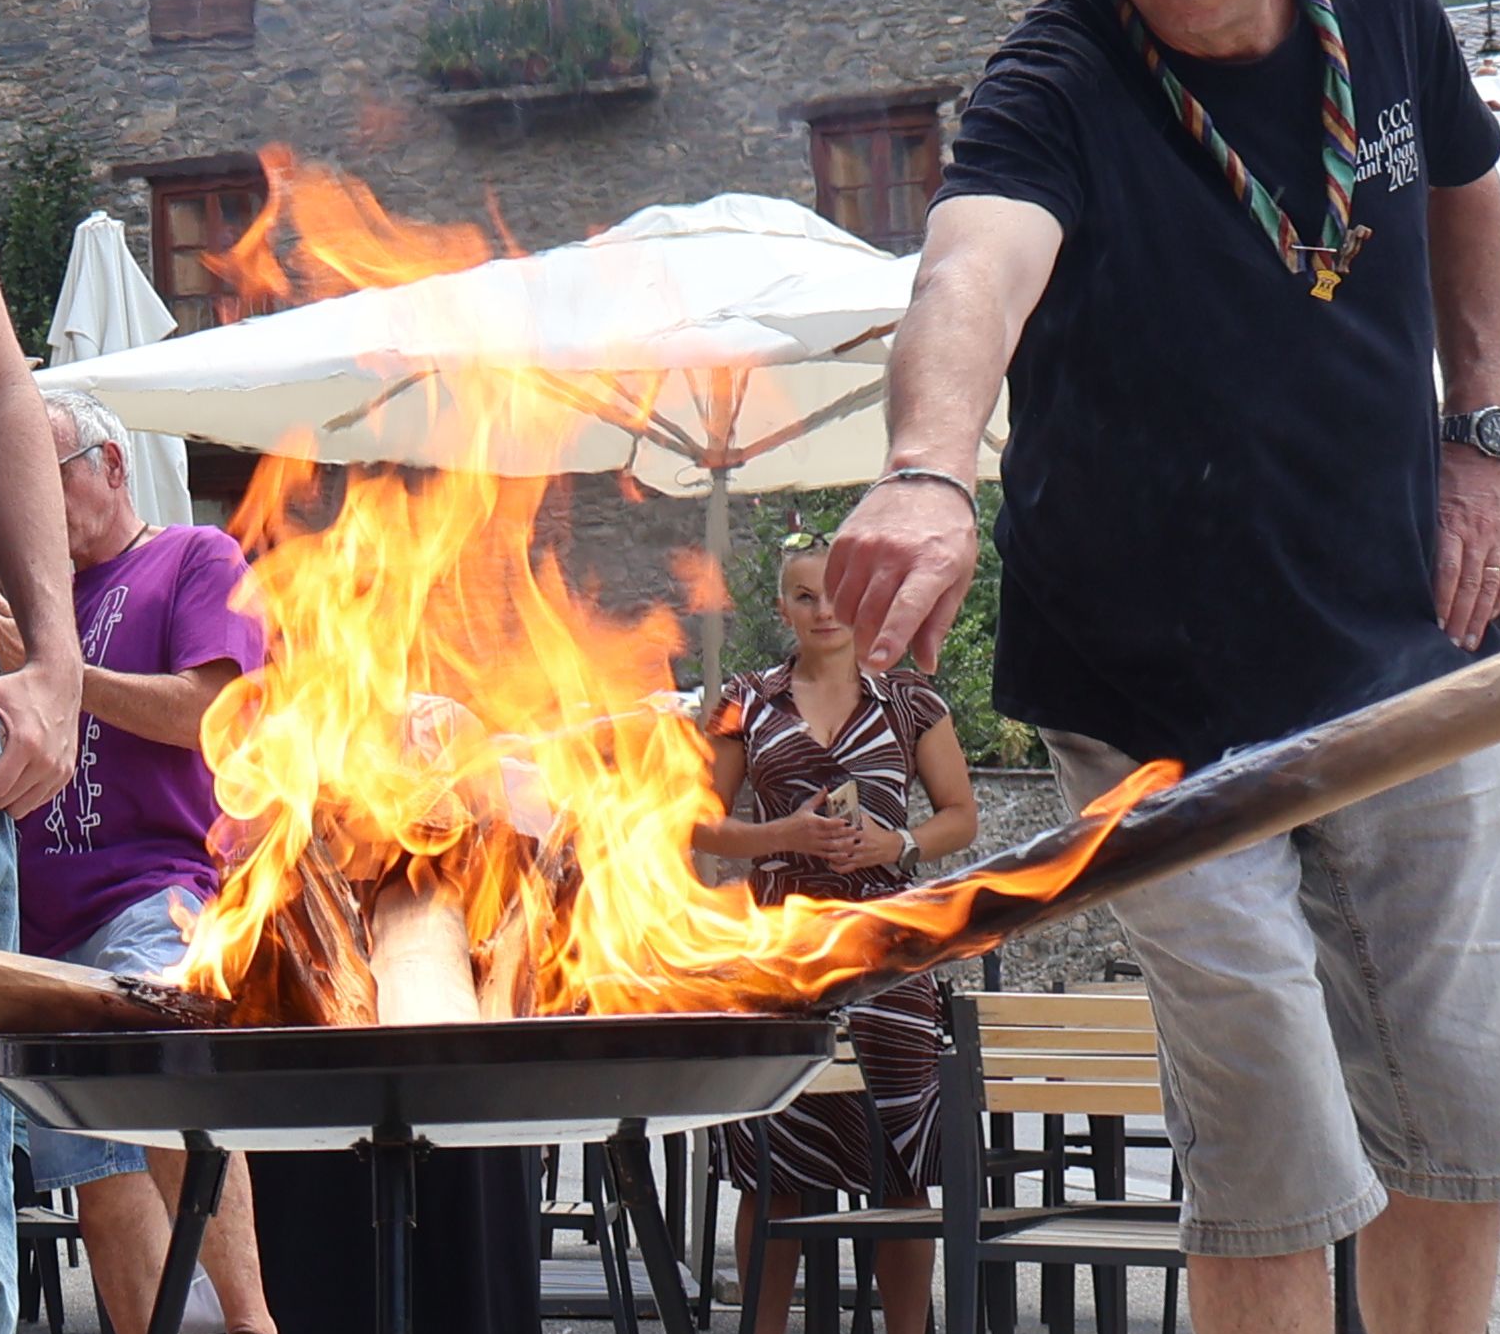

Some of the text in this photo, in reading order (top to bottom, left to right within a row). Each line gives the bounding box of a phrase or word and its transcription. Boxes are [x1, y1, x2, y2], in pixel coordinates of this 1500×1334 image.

[1377, 98, 1412, 135] CCC
[1353, 140, 1416, 183] ant Joan
[1355, 122, 1415, 165] Andorra
[1387, 151, 1420, 193] 2024
